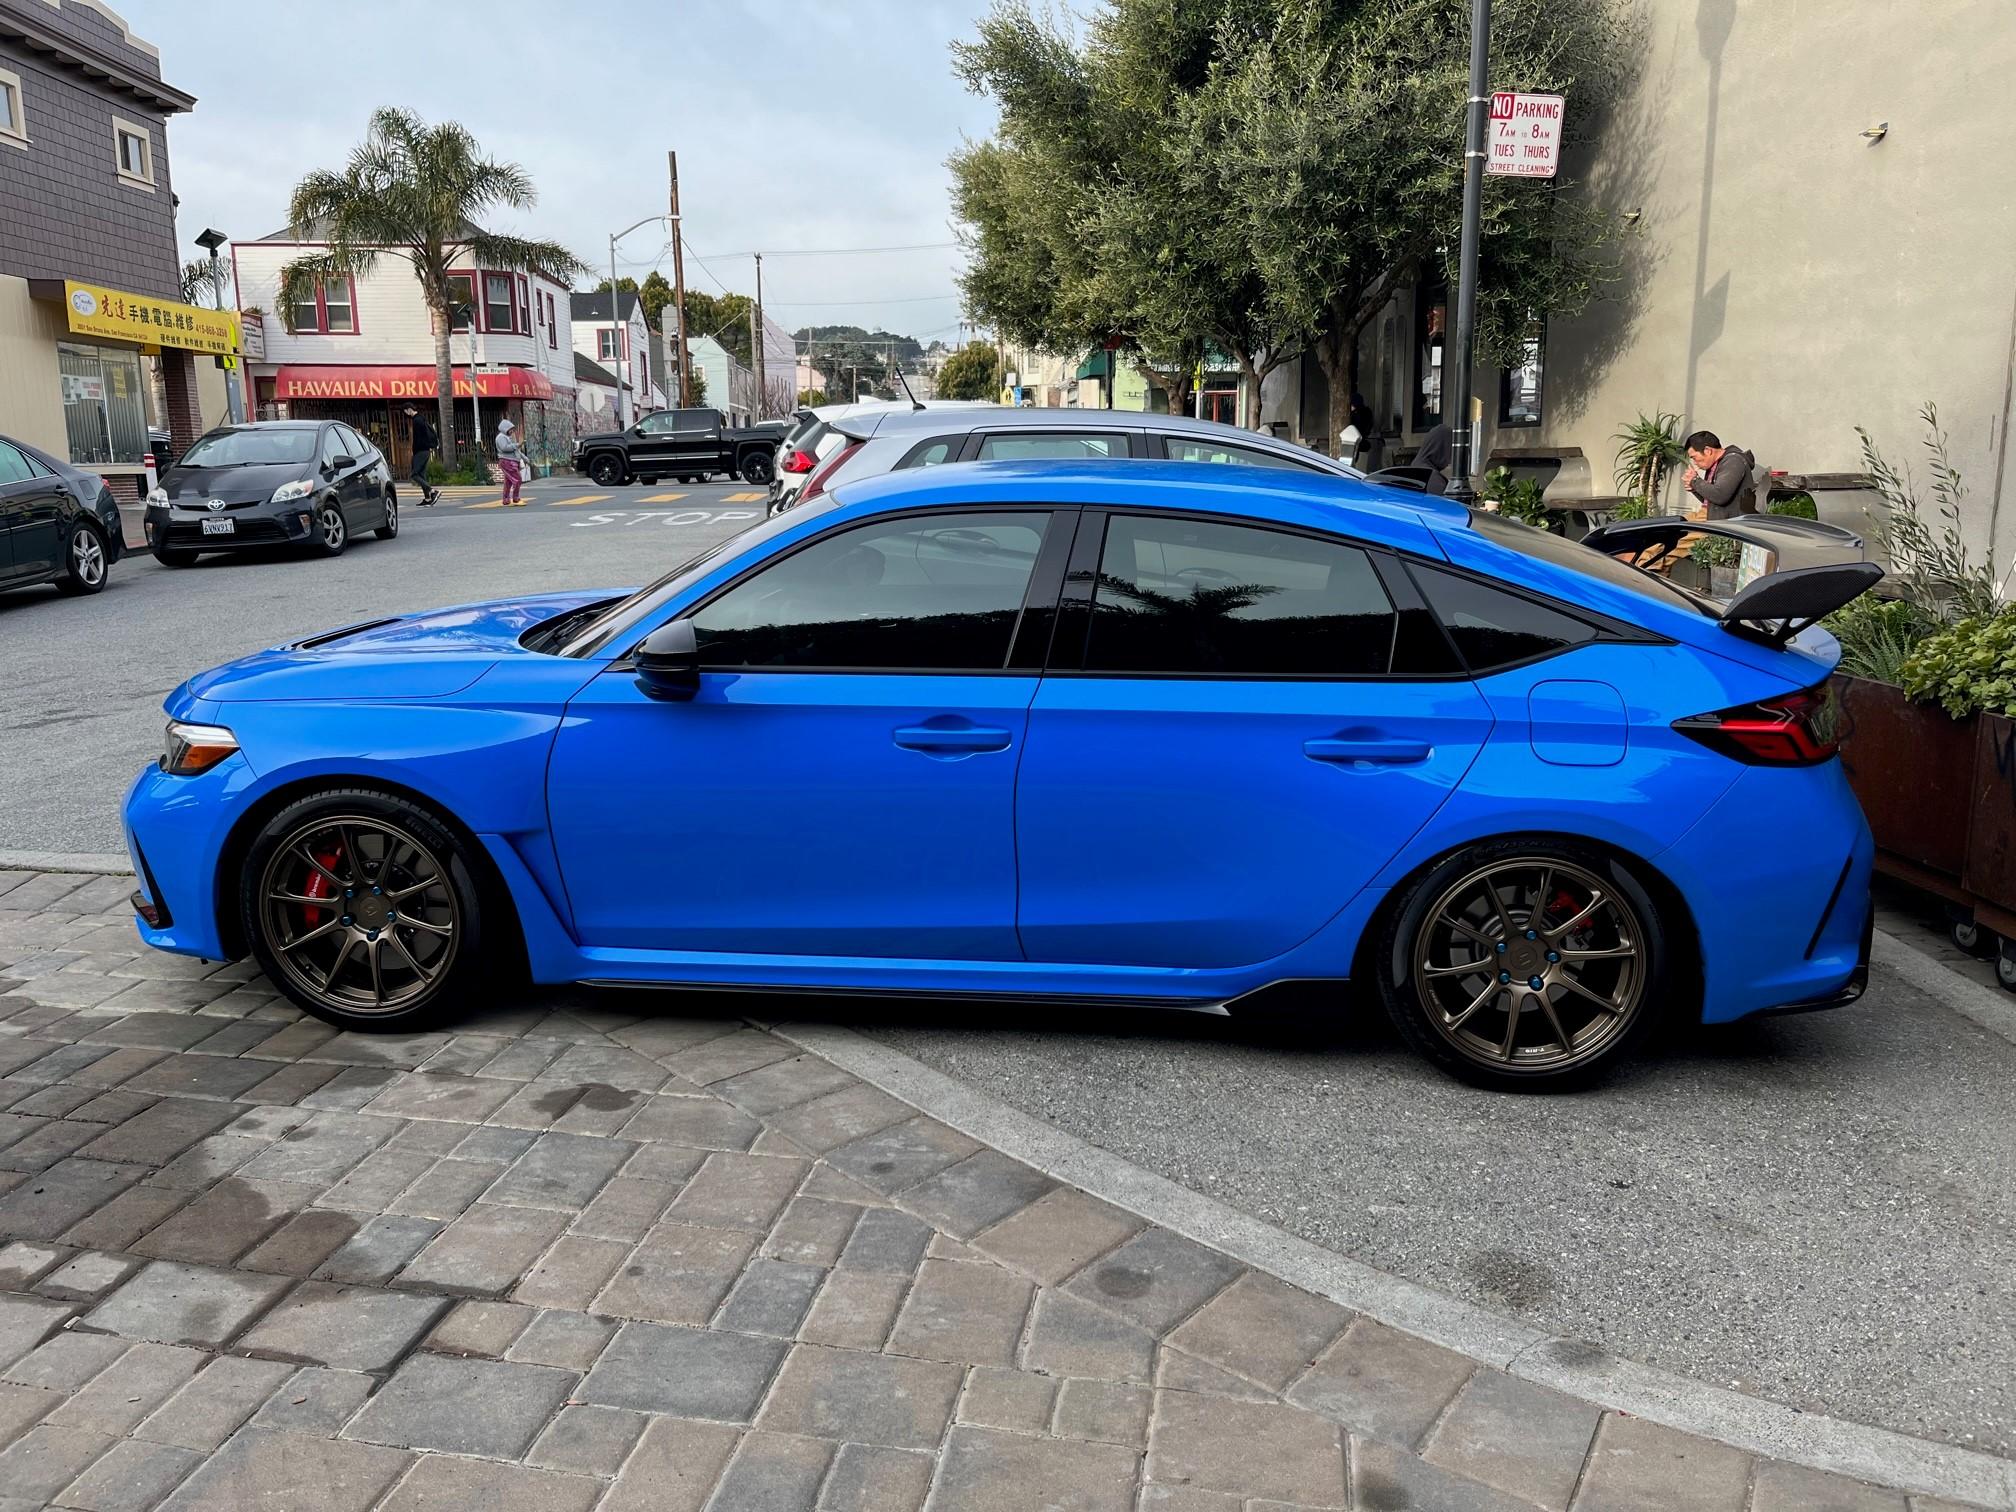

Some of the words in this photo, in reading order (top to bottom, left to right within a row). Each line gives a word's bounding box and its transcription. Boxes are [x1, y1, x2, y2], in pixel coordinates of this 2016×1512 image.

[1492, 96, 1512, 117] NO
[1516, 102, 1559, 119] PARKING
[1494, 144, 1515, 157] TUES
[1524, 145, 1550, 159] THURS
[1489, 163, 1515, 172] STREET
[1518, 164, 1550, 173] CLEANING
[288, 381, 383, 396] HAWAIIAN
[391, 380, 438, 396] DRIV
[570, 511, 759, 527] STOP
